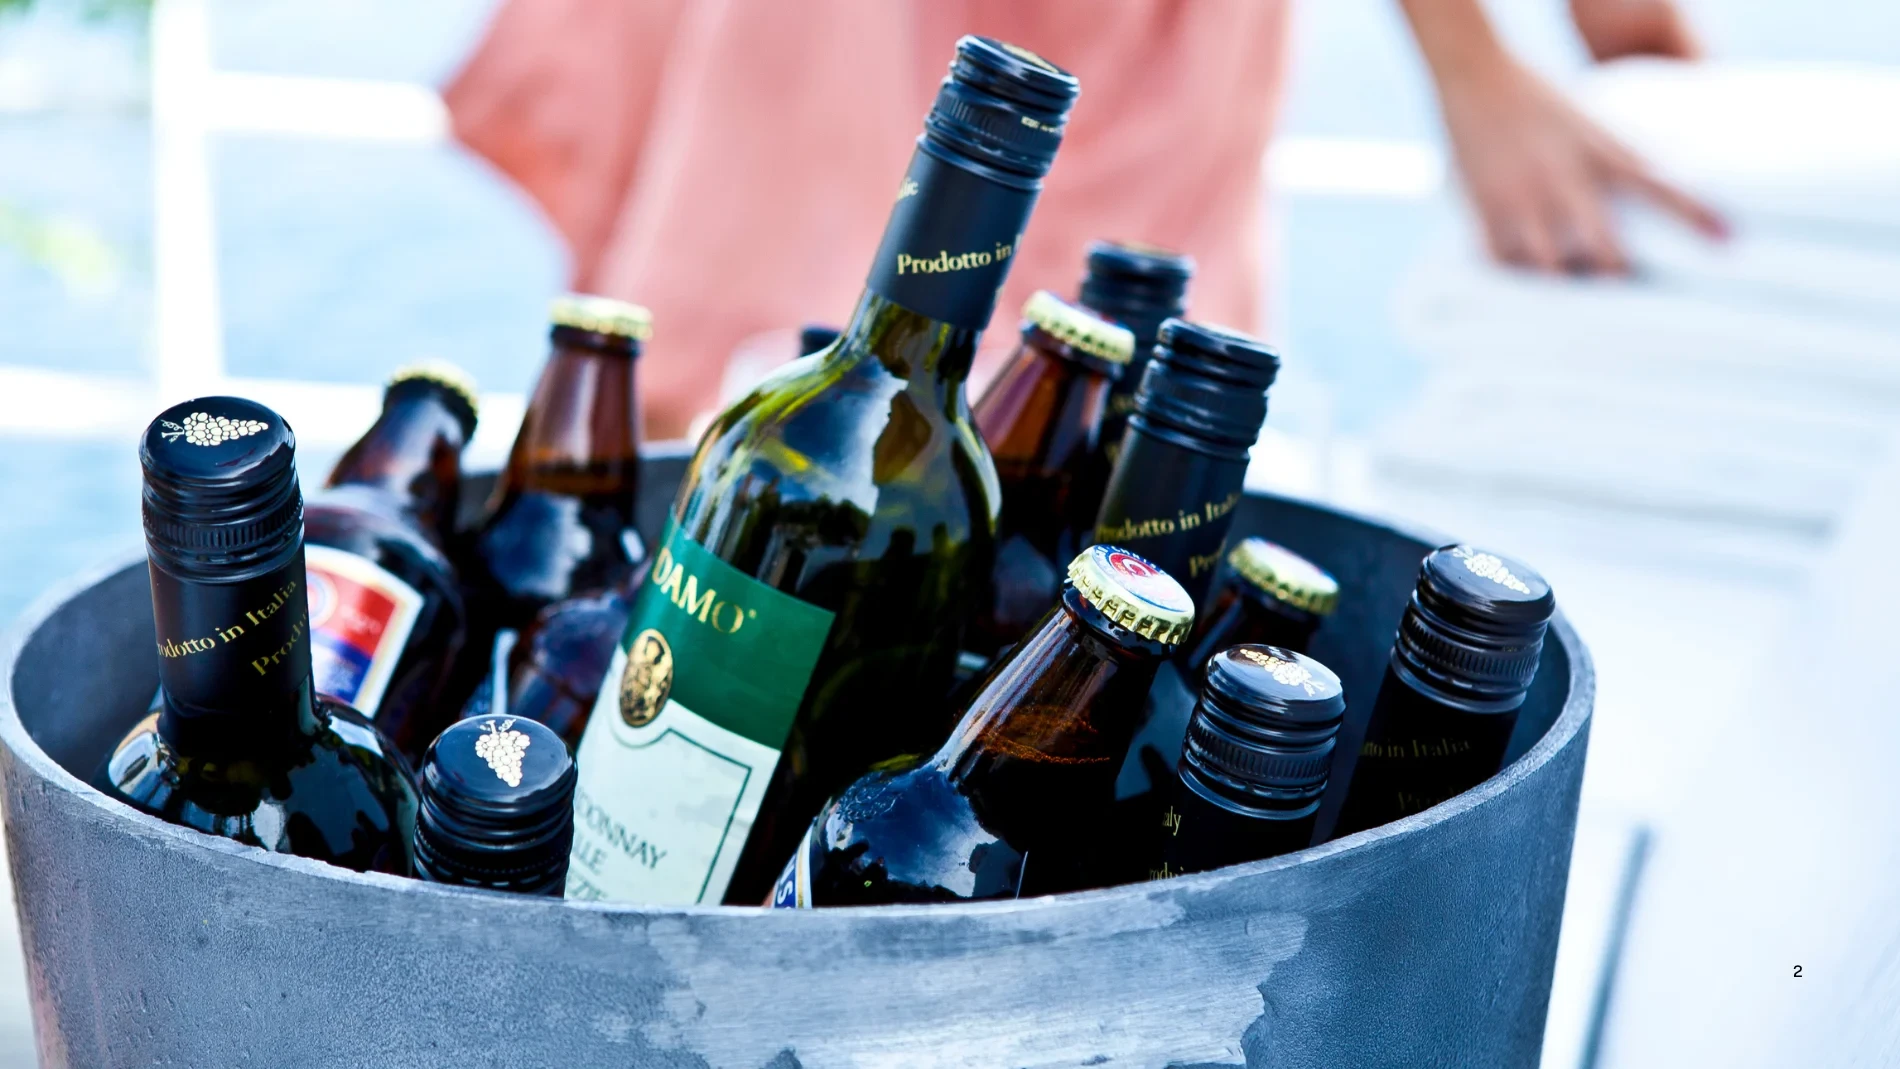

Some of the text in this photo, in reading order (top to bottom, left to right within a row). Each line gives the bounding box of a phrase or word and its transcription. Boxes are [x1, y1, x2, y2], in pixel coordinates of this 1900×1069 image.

[896, 250, 992, 275] Prodotto
[995, 241, 1012, 261] in
[1178, 509, 1201, 531] in
[215, 624, 245, 643] in
[246, 580, 297, 626] Italia
[1412, 738, 1471, 758] Italia
